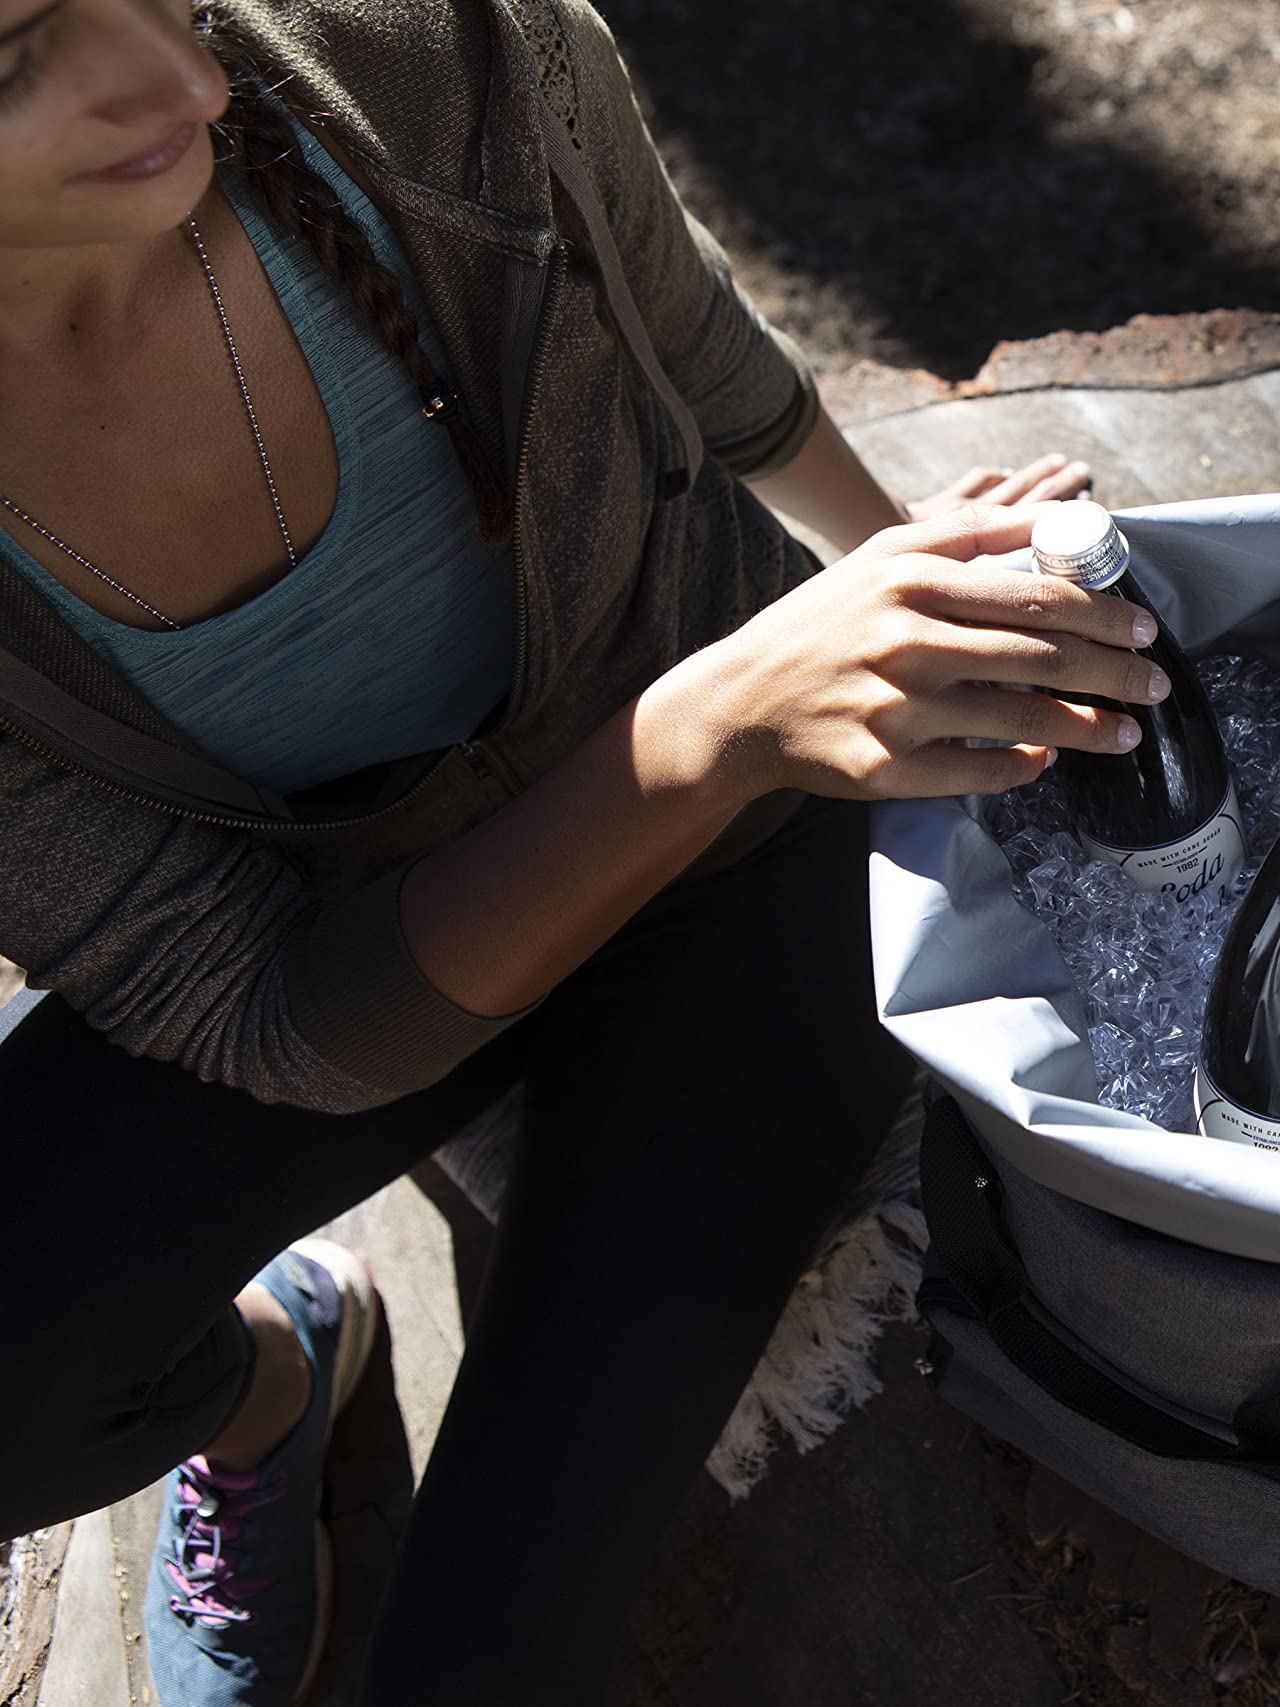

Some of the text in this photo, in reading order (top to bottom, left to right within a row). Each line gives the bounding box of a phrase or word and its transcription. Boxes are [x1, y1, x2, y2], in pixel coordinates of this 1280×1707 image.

[1160, 852, 1180, 863] WITH
[1182, 841, 1200, 855] CANE
[1176, 858, 1200, 874] 1982
[1221, 1112, 1240, 1125] MADE
[1243, 1122, 1264, 1134] WITH
